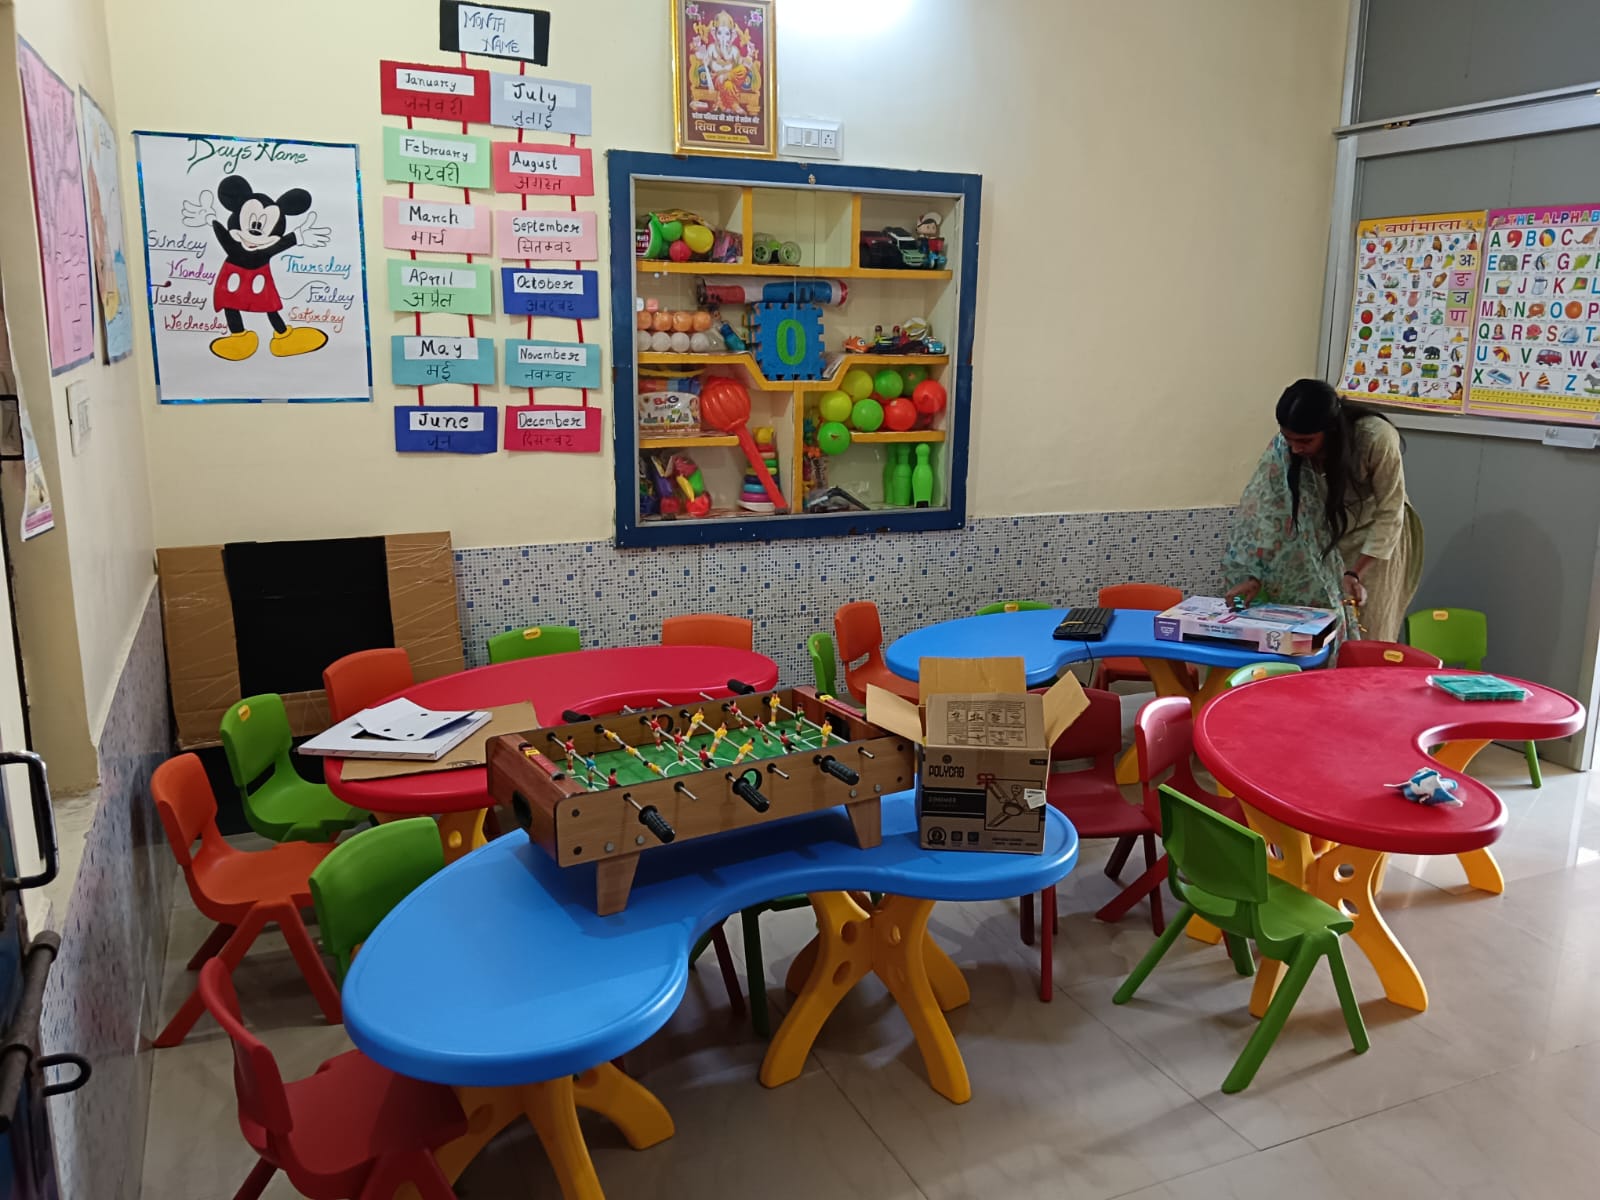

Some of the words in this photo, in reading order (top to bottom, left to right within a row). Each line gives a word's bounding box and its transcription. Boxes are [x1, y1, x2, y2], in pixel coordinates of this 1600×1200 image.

[464, 11, 506, 33] MONTH
[481, 35, 520, 53] NAME
[405, 73, 457, 92] January
[512, 82, 556, 112] July
[186, 138, 251, 174] Days
[255, 142, 308, 163] Name
[405, 138, 468, 162] February
[512, 151, 558, 172] August
[409, 205, 459, 225] March
[1508, 213, 1535, 225] THE
[1542, 209, 1600, 224] ALPHAB
[513, 217, 581, 234] September
[1385, 219, 1462, 234] वर्णमाला
[147, 230, 208, 258] Sunday
[1490, 231, 1501, 247] A
[1525, 230, 1537, 246] B
[1561, 228, 1573, 246] C
[167, 258, 217, 284] Monday
[280, 254, 351, 279] Thursday
[1488, 255, 1498, 271] E
[1521, 254, 1532, 270] F
[1557, 253, 1570, 270] G
[408, 268, 453, 286] April
[516, 275, 574, 290] October
[1517, 278, 1527, 294] J
[1553, 277, 1566, 294] K
[150, 280, 208, 310] Tuesday
[302, 282, 355, 309] Friday
[288, 306, 344, 333] Saturday
[1481, 301, 1494, 317] M
[1514, 301, 1526, 317] N
[1550, 301, 1563, 318] O
[1588, 302, 1600, 319] P
[164, 310, 228, 335] Wednesday
[1478, 323, 1490, 340] Q
[1511, 324, 1523, 340] R
[1546, 325, 1558, 342] S
[1585, 326, 1597, 343] T
[520, 347, 580, 361] November
[1476, 345, 1488, 361] U
[1521, 348, 1532, 364] V
[1570, 350, 1588, 367] W
[1472, 368, 1484, 384] X
[1519, 371, 1530, 387] Y
[1565, 374, 1577, 391] Z
[418, 412, 469, 429] June
[518, 411, 582, 428] December
[928, 765, 965, 778] POLYCAB
